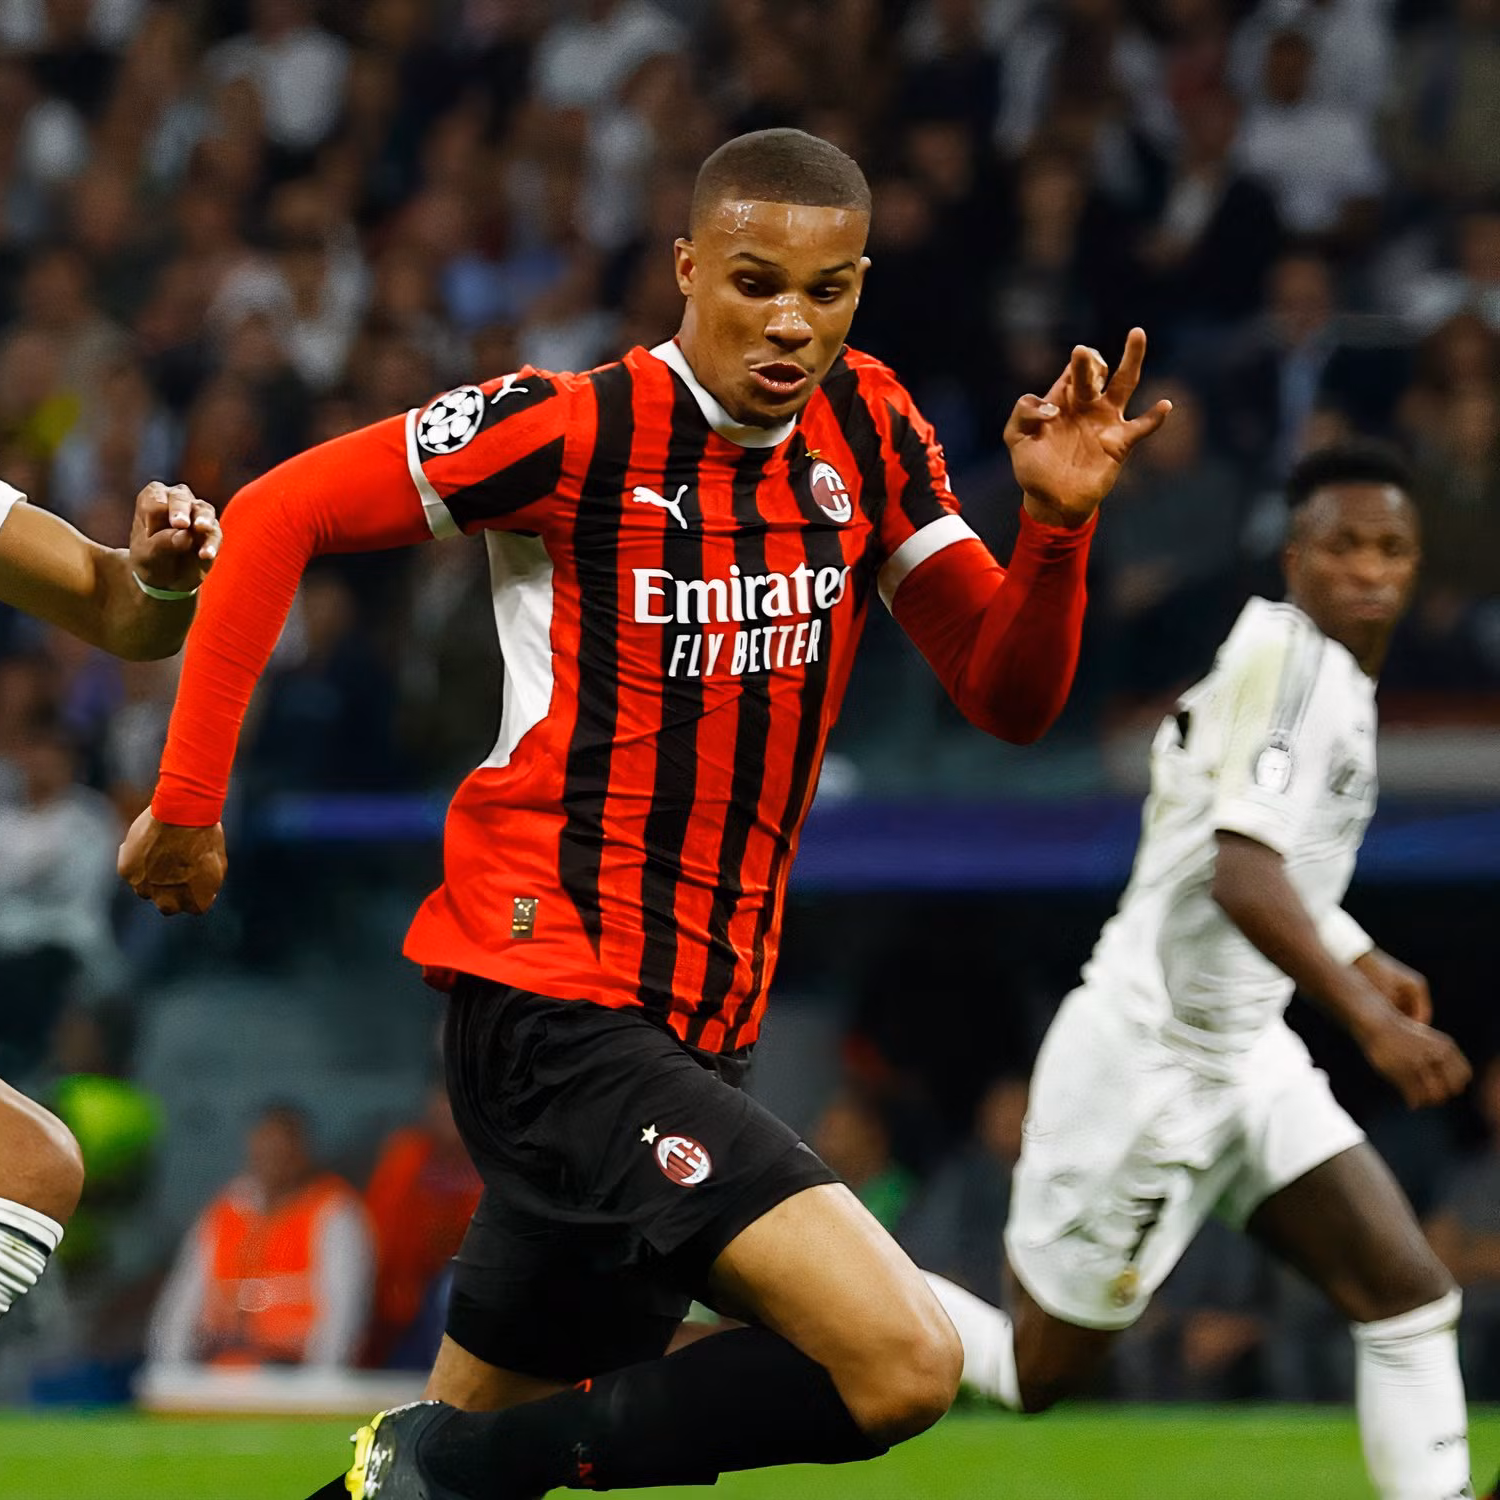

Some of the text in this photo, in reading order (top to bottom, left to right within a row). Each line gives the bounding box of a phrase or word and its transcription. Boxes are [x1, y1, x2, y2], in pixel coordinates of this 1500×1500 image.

[631, 562, 851, 624] Emirates
[668, 619, 822, 677] FLY BETTER
